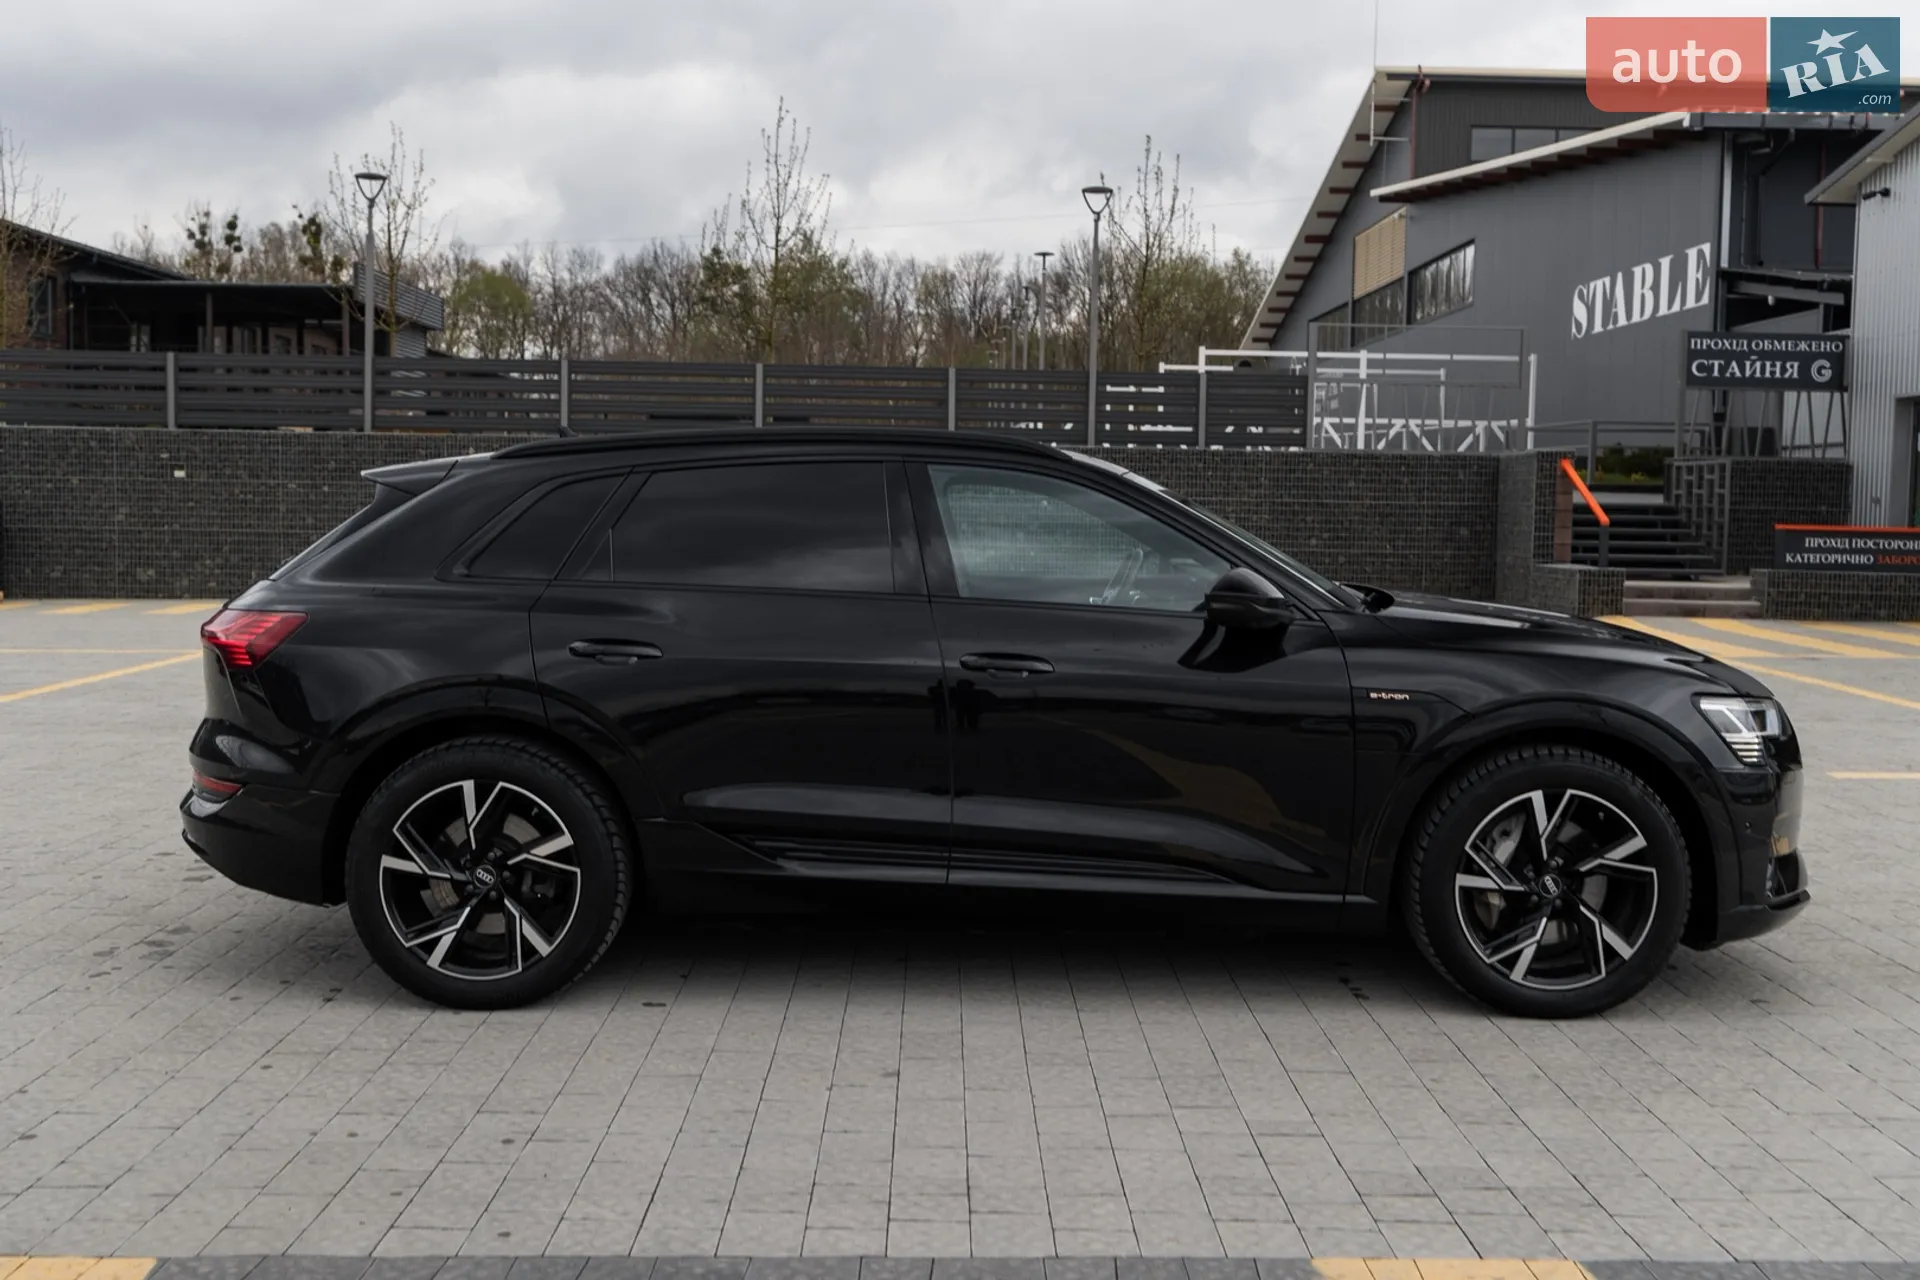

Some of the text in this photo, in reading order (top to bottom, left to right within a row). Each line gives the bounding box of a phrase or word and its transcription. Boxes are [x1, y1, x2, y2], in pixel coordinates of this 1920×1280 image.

[1571, 242, 1712, 341] STABLE
[1690, 337, 1843, 353] ПРОХІД ОБМЕЖЕНО
[1691, 355, 1800, 379] СТАЙНЯ
[1804, 536, 1849, 550] ПРОХІД
[1785, 552, 1874, 565] КАТЕГОРИЧНО
[1369, 692, 1410, 701] e-tron
